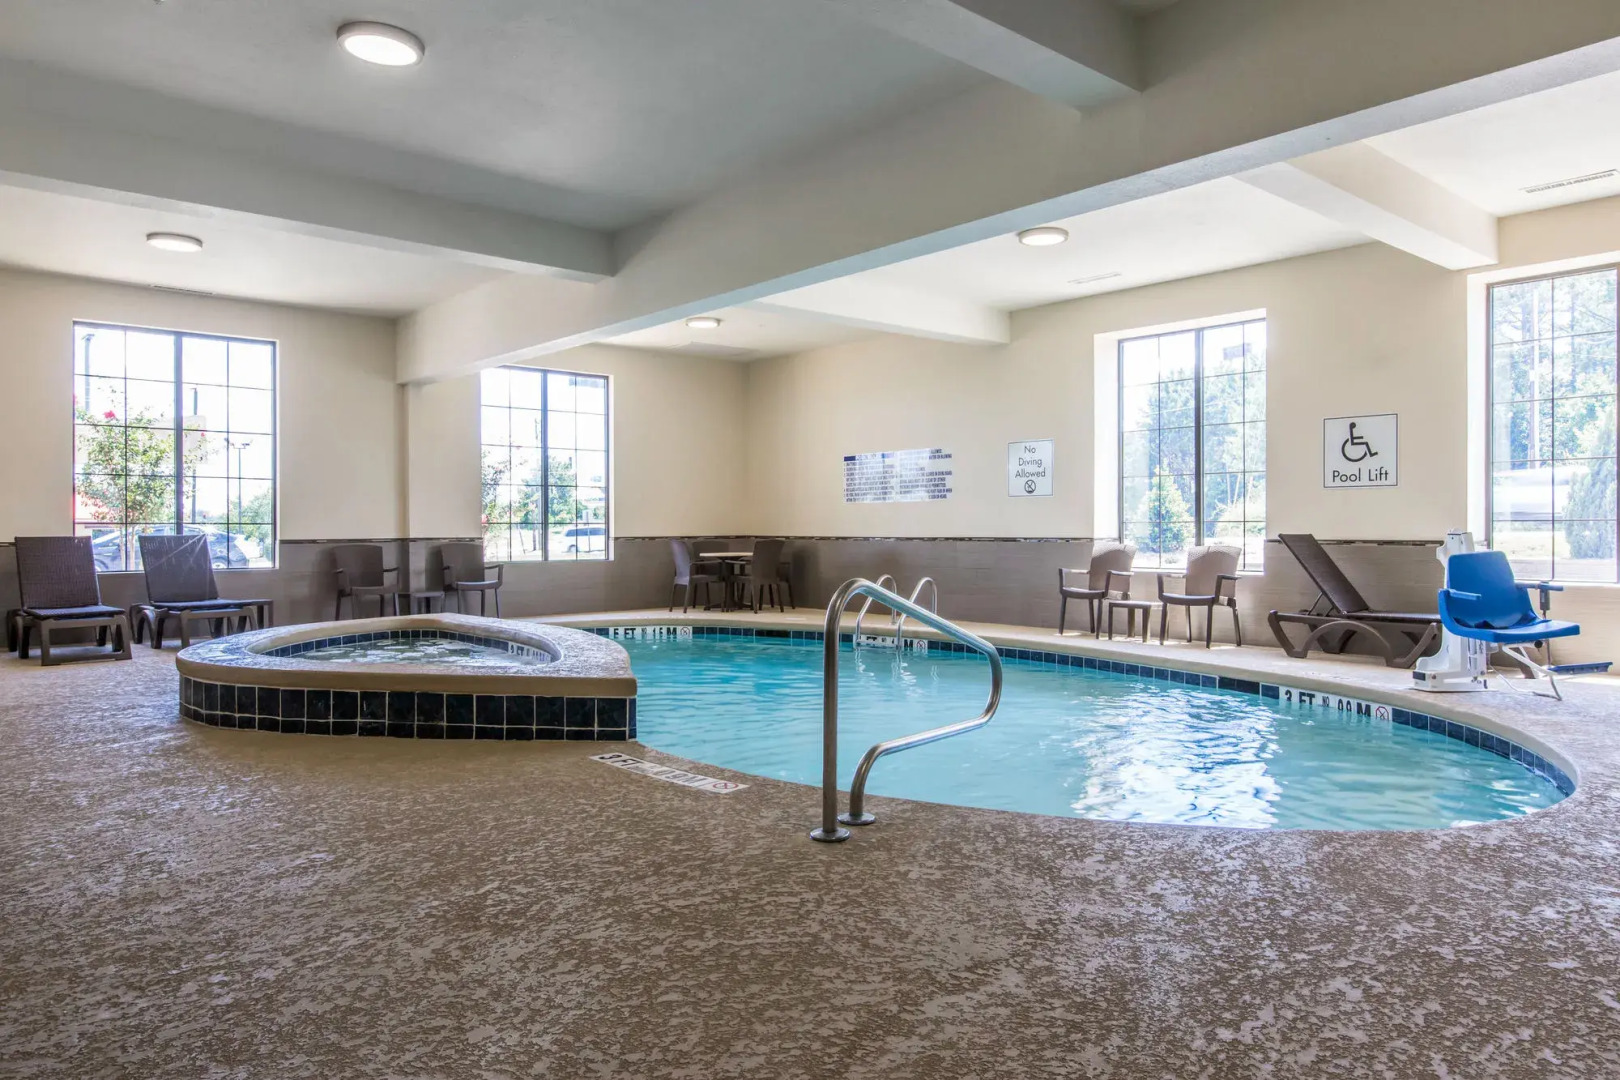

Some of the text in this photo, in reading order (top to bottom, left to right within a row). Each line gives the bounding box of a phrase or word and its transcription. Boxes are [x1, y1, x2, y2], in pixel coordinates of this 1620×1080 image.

[1024, 445, 1036, 454] No
[1018, 457, 1043, 468] Diving
[1015, 467, 1046, 478] Allowed
[1332, 466, 1389, 483] Pool Lift
[624, 627, 636, 639] FT
[1298, 691, 1316, 706] FT
[1356, 702, 1371, 718] M
